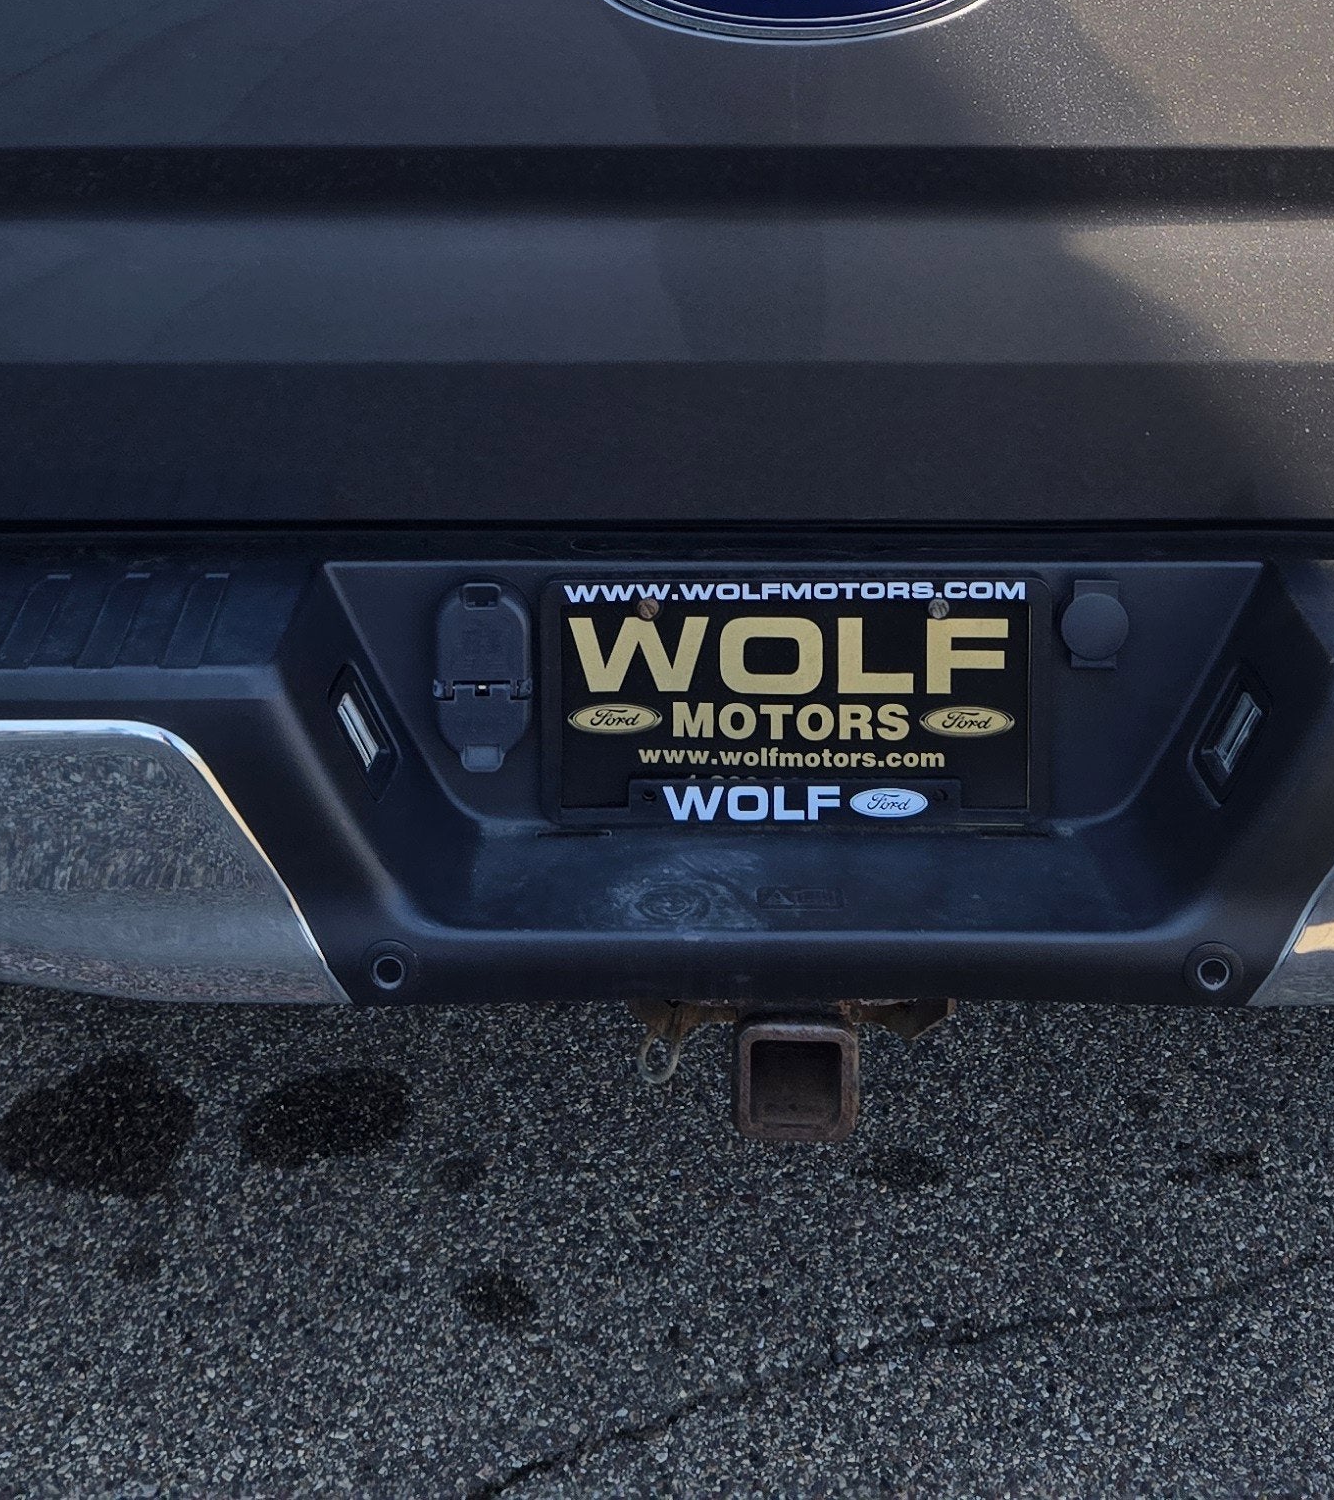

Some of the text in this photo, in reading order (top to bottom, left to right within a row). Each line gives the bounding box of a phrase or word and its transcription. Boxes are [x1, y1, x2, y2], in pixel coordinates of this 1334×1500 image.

[564, 581, 1026, 603] WWW.WOLFMOTORS.COM
[568, 616, 1009, 695] WOLF
[672, 701, 910, 741] MOTORS
[638, 747, 945, 768] www.wolfmotors.com
[662, 785, 841, 821] WOLF
